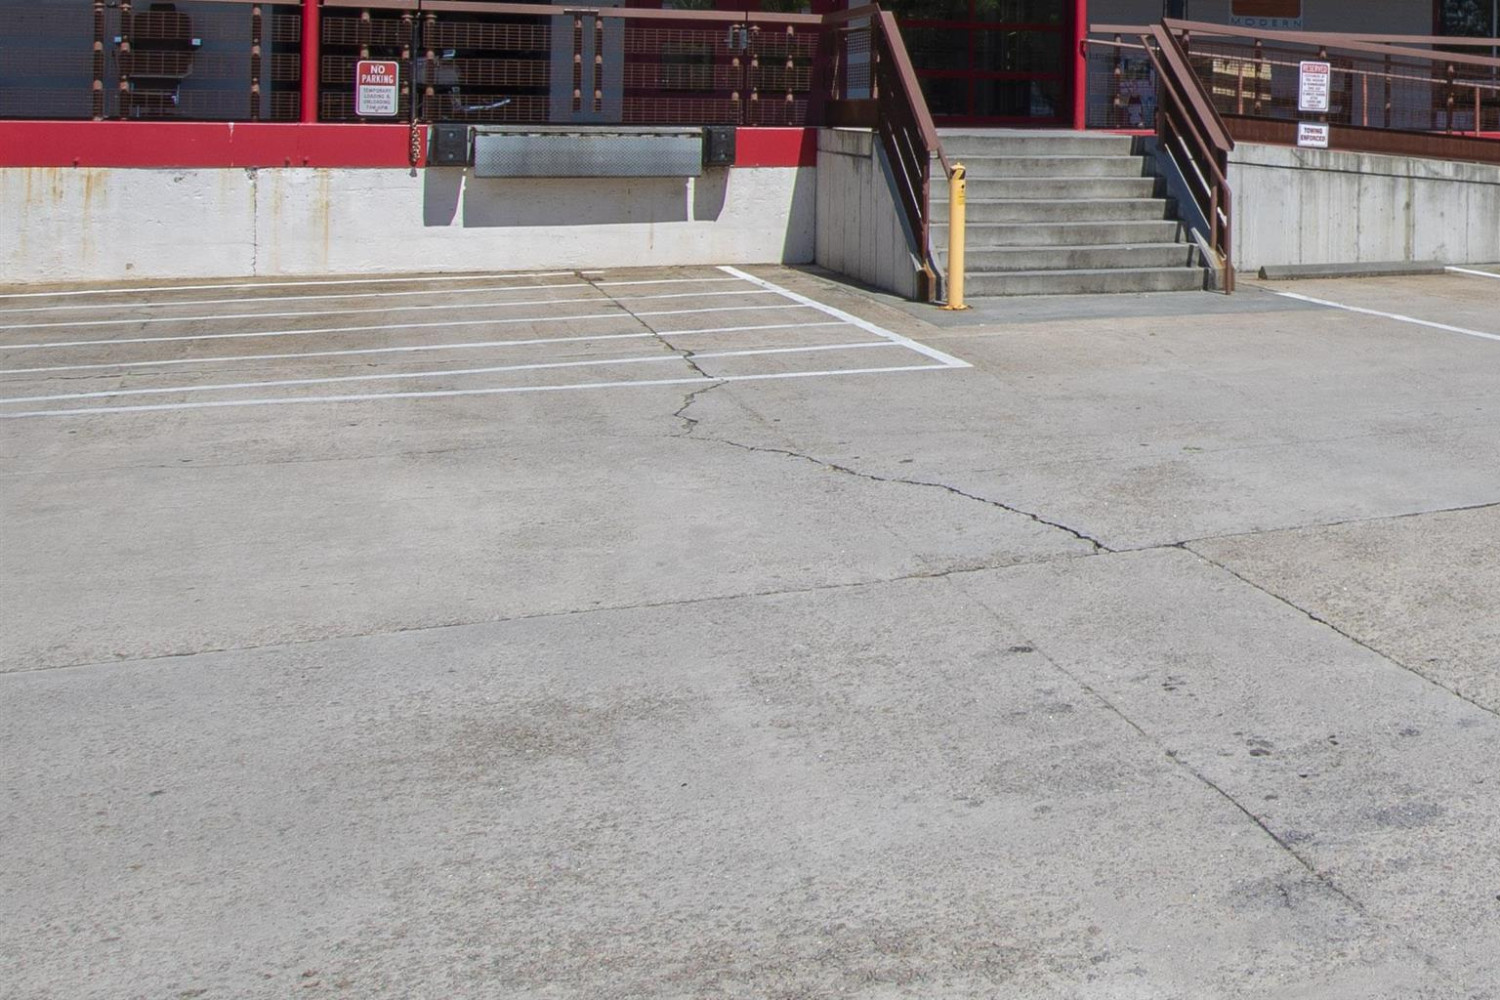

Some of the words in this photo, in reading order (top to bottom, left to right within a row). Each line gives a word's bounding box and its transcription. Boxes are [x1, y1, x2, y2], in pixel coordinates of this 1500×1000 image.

[1231, 17, 1303, 28] MODERN
[370, 65, 385, 74] NO
[361, 74, 394, 84] PARKING
[1300, 134, 1326, 142] ENFORCED
